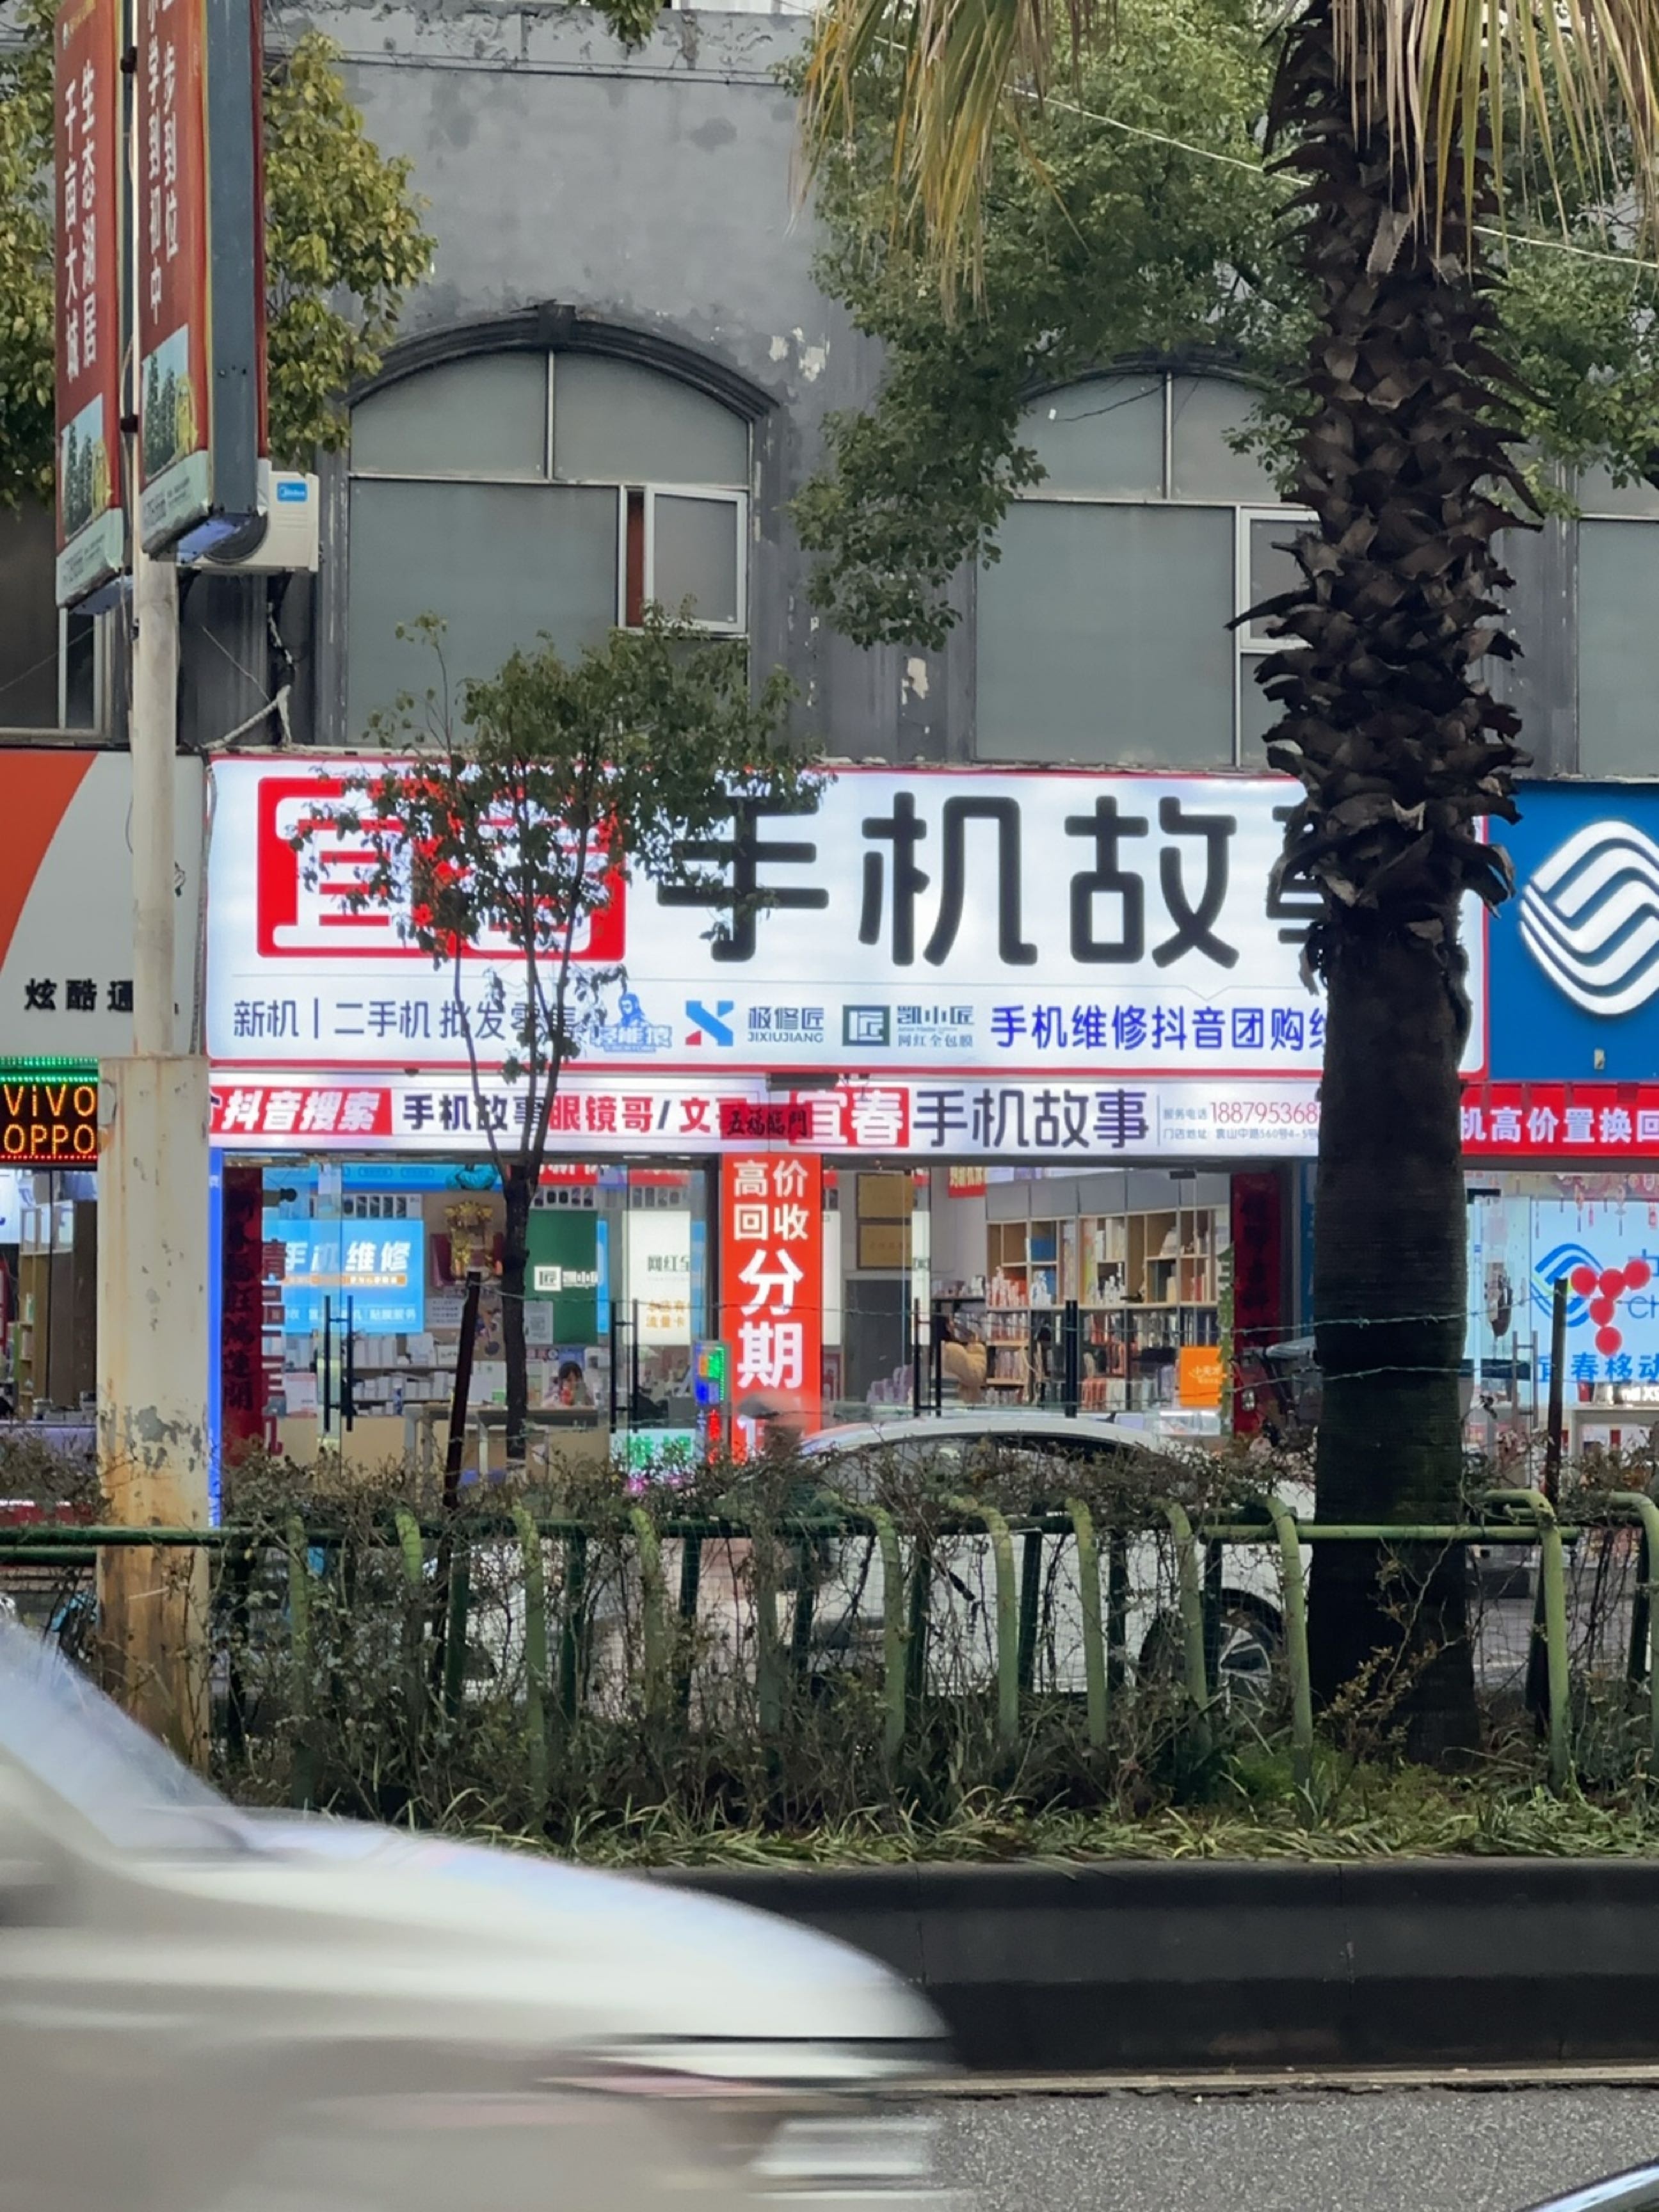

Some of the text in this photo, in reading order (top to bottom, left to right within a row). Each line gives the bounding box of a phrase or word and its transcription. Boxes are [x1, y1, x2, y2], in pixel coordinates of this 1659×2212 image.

[163, 0, 179, 262] 步到位
[748, 1032, 824, 1043] JIXIUJIANG
[913, 1088, 1150, 1149] 手机故事
[1210, 1102, 1320, 1125] 188795368
[3, 1123, 95, 1155] OPPO
[733, 1160, 808, 1198] 高价
[733, 1203, 809, 1241] 回收
[737, 1249, 804, 1389] 分期
